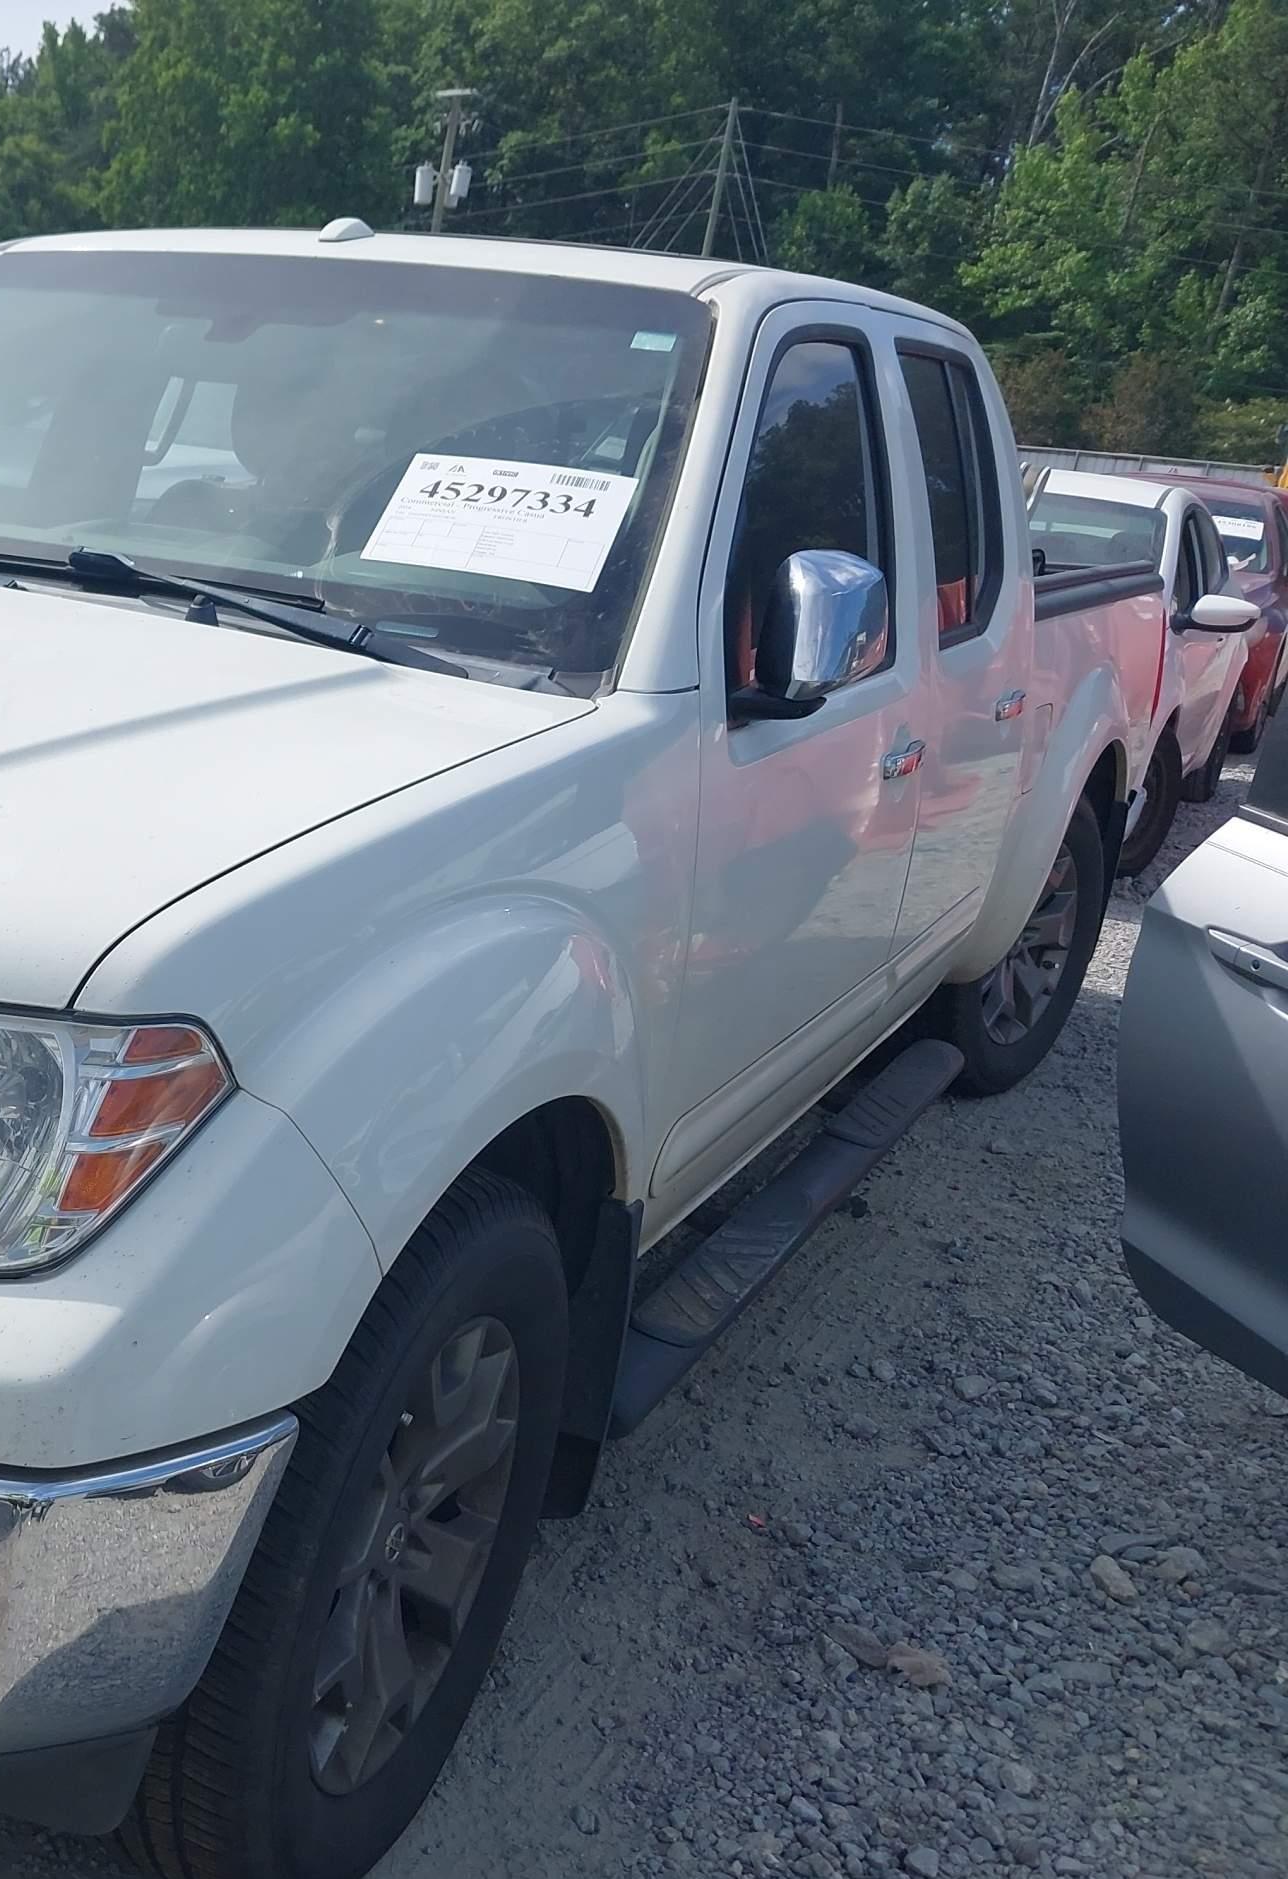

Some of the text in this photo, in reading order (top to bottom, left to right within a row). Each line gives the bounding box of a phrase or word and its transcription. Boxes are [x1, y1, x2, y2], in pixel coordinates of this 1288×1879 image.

[400, 496, 455, 508] Commercial
[463, 503, 515, 515] Progressive
[419, 479, 598, 518] 45297334
